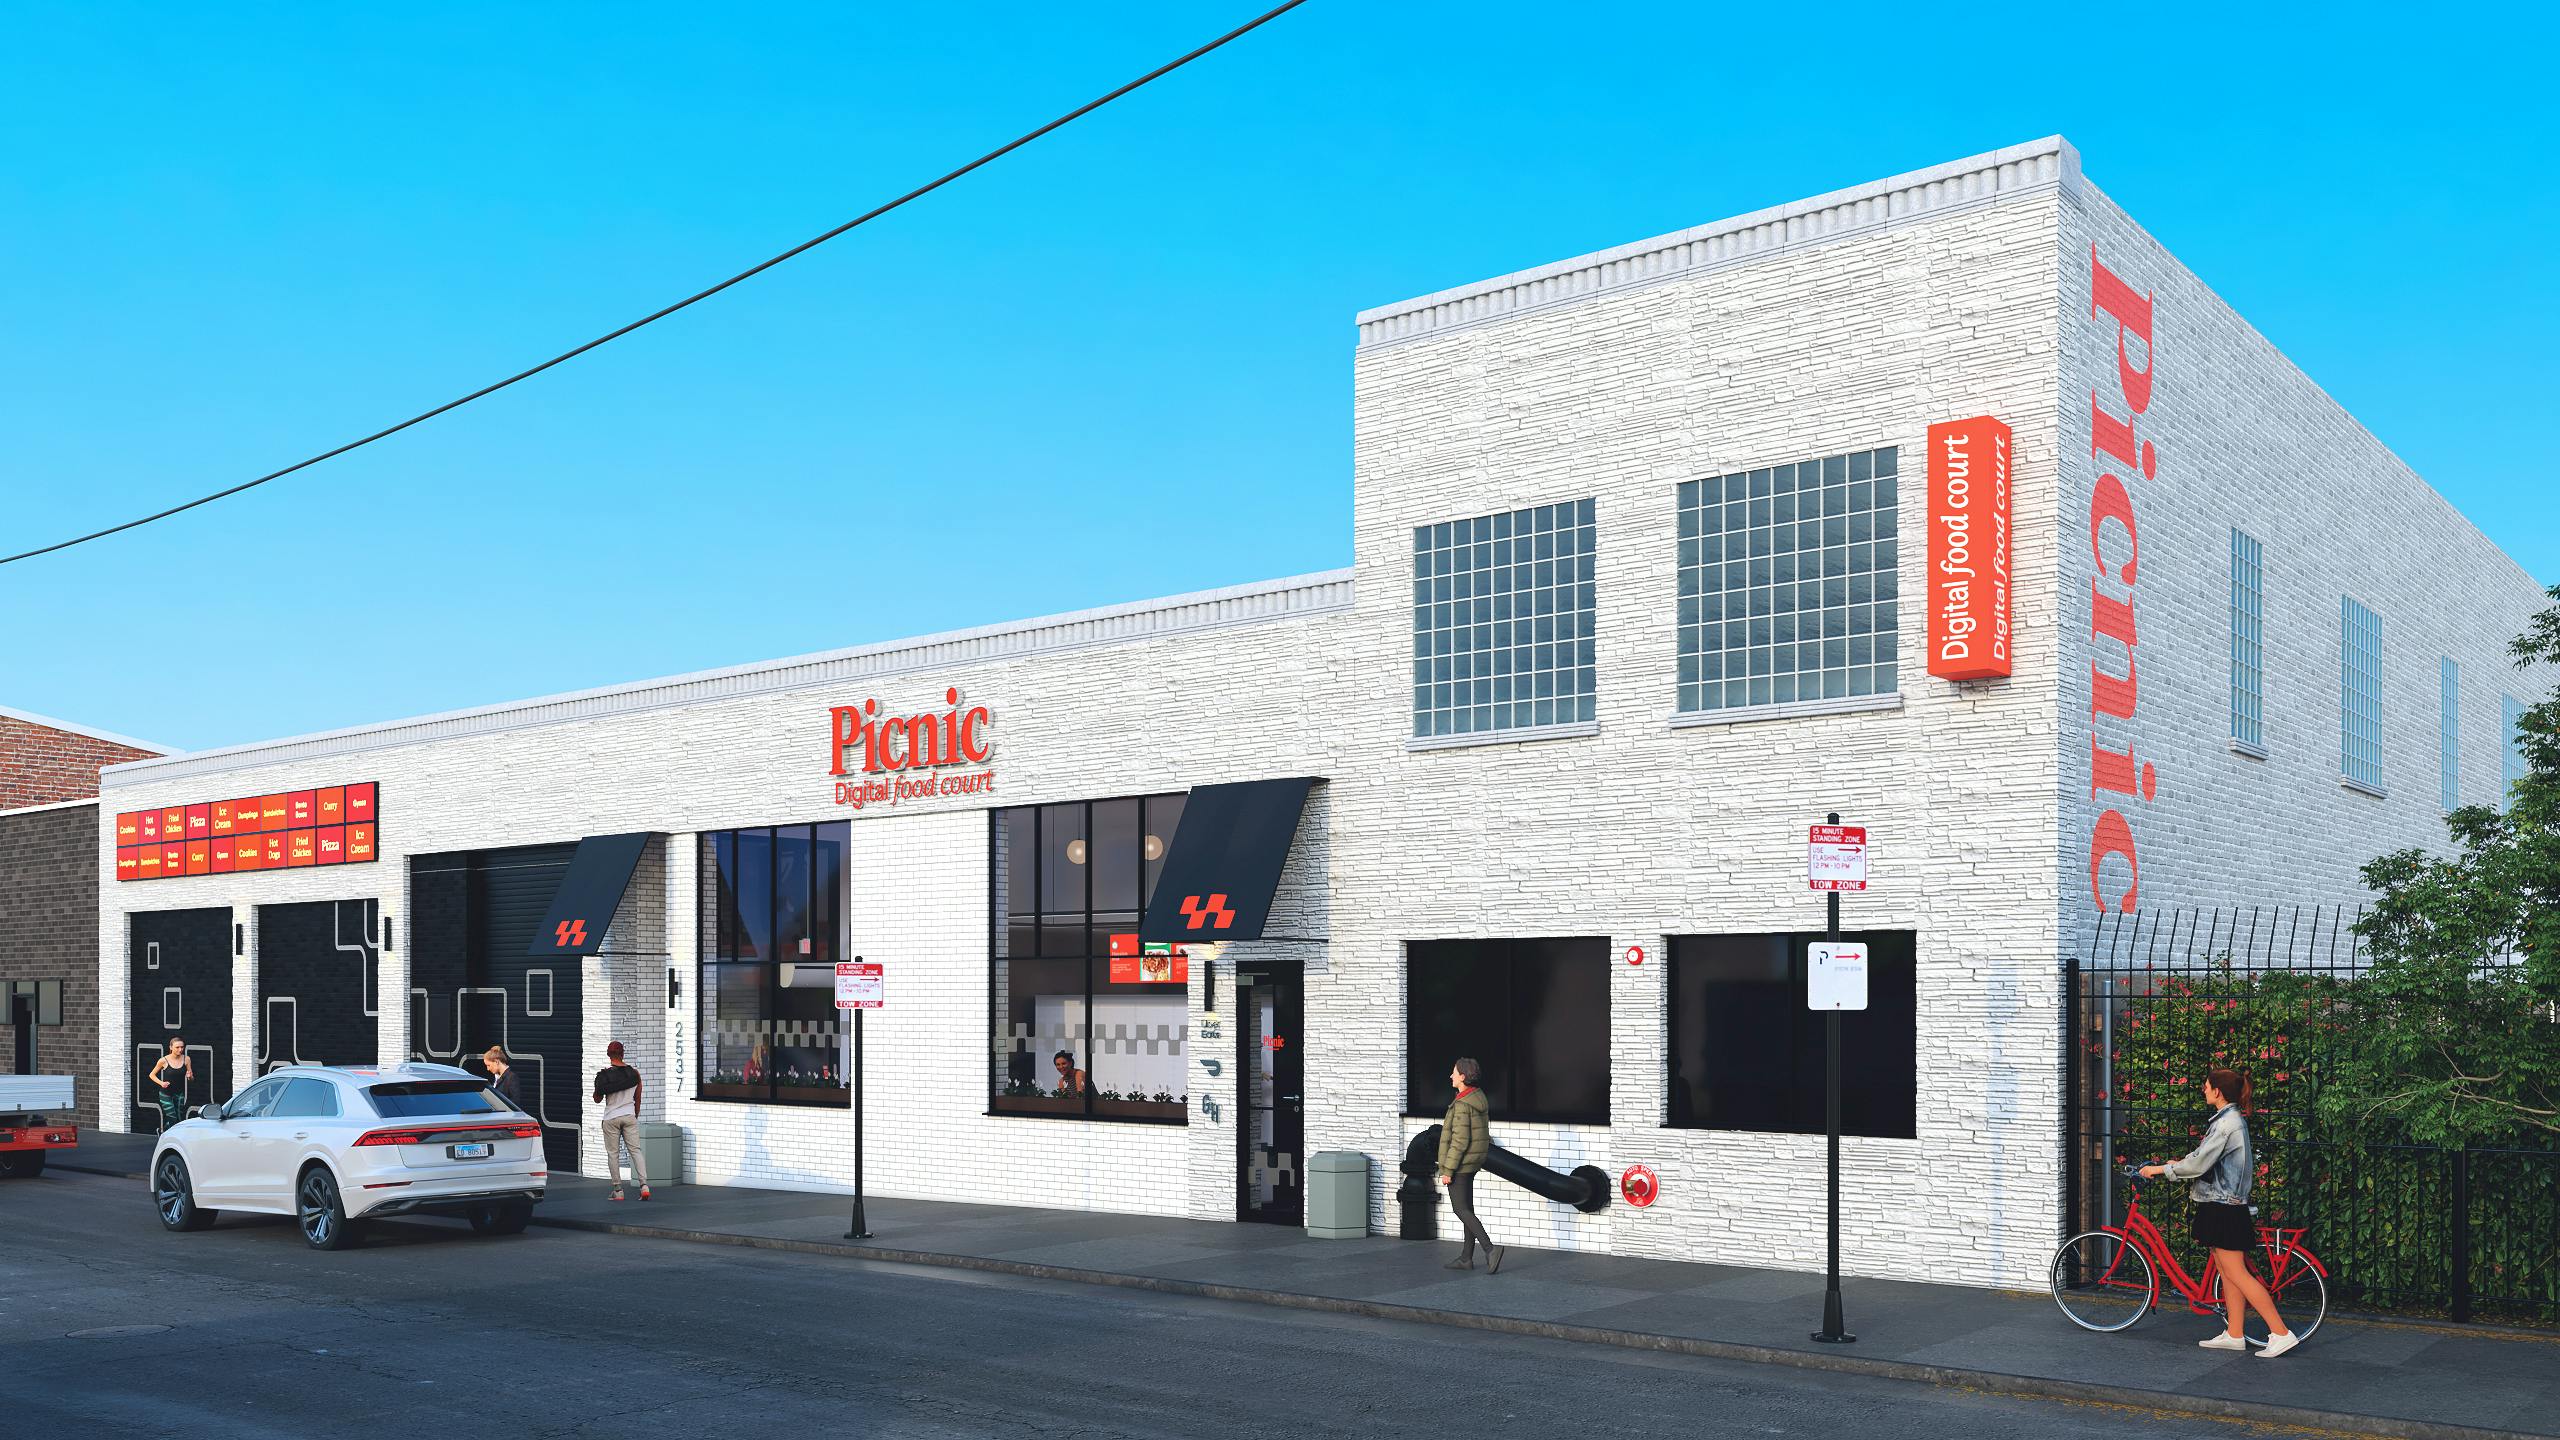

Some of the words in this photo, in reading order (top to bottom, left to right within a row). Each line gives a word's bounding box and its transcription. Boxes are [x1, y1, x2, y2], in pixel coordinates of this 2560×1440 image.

[1943, 434, 1969, 509] court
[1994, 434, 2006, 510] court
[1940, 515, 1976, 577] food
[1993, 512, 2008, 582] food
[2091, 240, 2156, 914] Picnic
[1941, 582, 1976, 660] Digital
[1993, 580, 2008, 661] Digital
[829, 687, 992, 775] Picnic
[835, 777, 889, 809] Digital
[892, 771, 936, 806] food
[940, 769, 994, 795] court
[218, 806, 227, 817] Ice
[323, 801, 338, 812] Curry
[145, 816, 154, 825] Hot
[189, 816, 206, 828] Pizza
[214, 819, 232, 830] Cream
[144, 827, 156, 837] Dogs
[165, 824, 182, 834] Chicken
[355, 829, 365, 840] Ice
[1821, 827, 1844, 835] MINUTE
[268, 838, 279, 848] Hot
[295, 836, 309, 847] Fried
[321, 839, 340, 852] Pizza
[238, 847, 258, 858] Cookies
[292, 847, 312, 858] Chicken
[350, 843, 370, 855] Cream
[191, 852, 205, 862] Curry
[268, 850, 281, 861] Dogs
[1813, 881, 1833, 889] TOW
[1836, 881, 1862, 890] ZONE
[1263, 1034, 1285, 1047] Picnic
[675, 1021, 684, 1092] 2537
